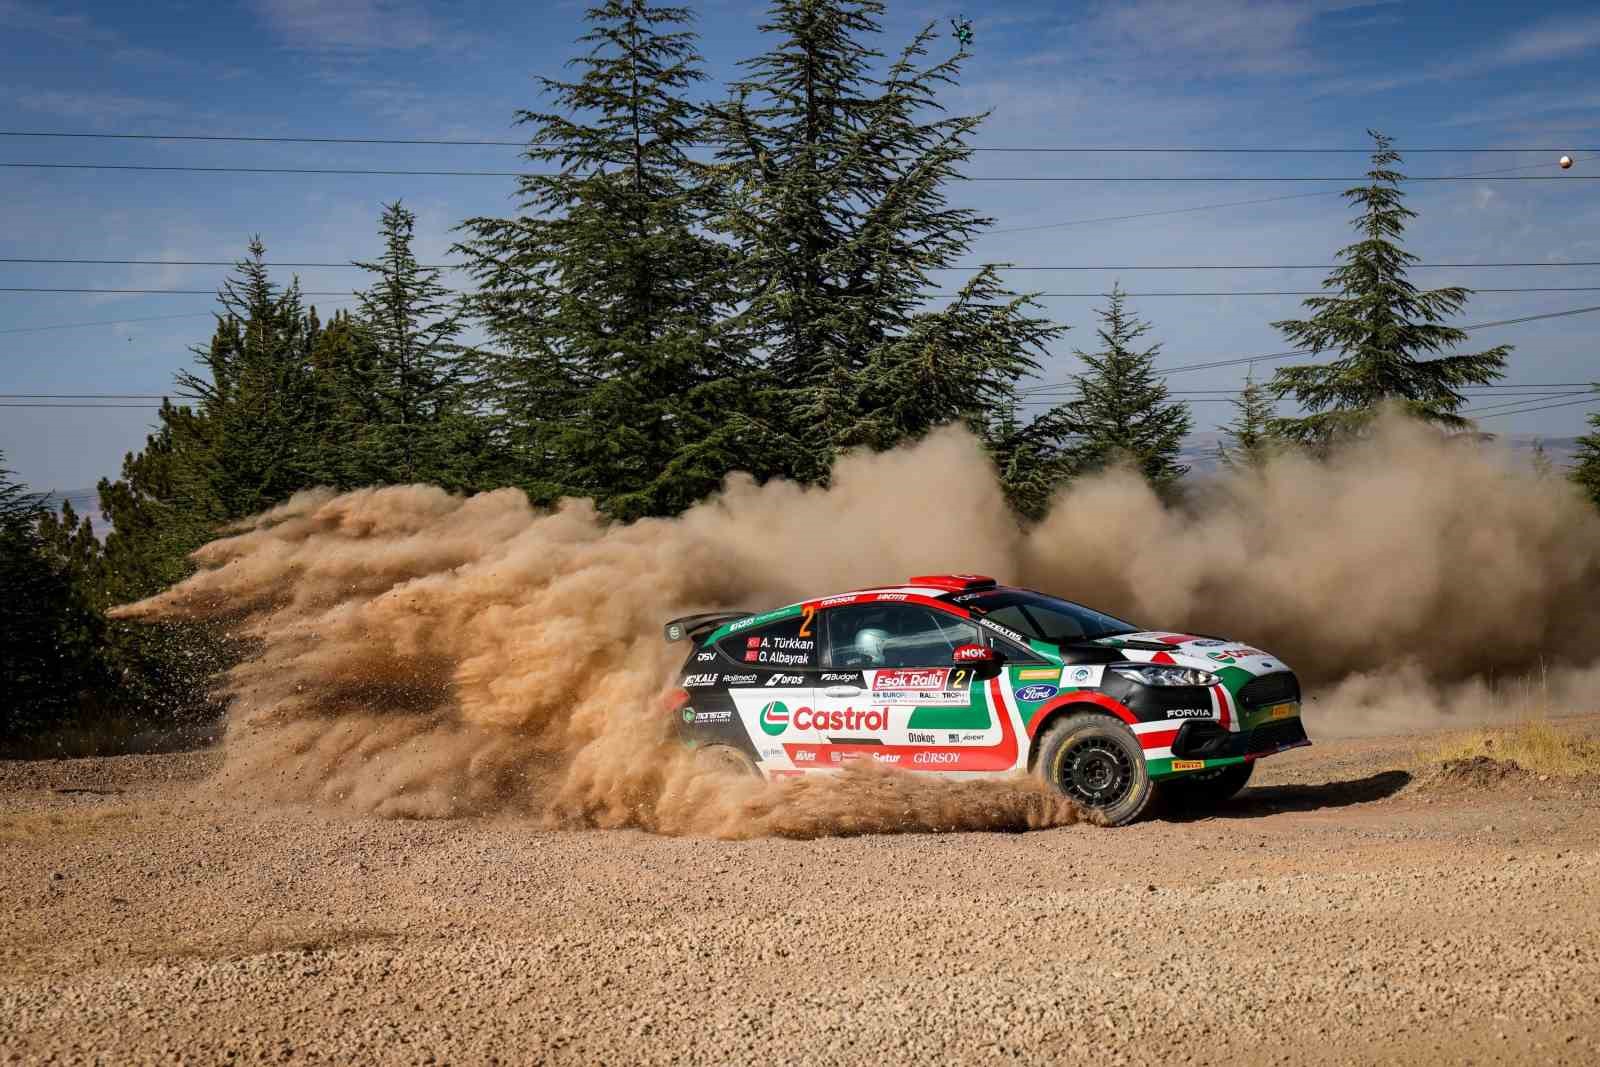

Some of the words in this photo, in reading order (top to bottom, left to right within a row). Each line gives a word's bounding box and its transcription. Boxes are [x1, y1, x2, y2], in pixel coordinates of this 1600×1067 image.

[799, 605, 815, 637] 2
[760, 638, 771, 648] A.
[774, 637, 814, 650] Türkkan
[697, 653, 717, 661] DSV
[769, 651, 809, 665] Albayrak
[961, 649, 986, 658] NGK
[781, 675, 805, 685] DFDS
[830, 673, 859, 683] Budget
[910, 673, 943, 688] Rally
[953, 670, 966, 689] 2
[793, 706, 889, 731] Castrol
[1166, 709, 1211, 718] FORVIA
[908, 732, 936, 744] Otokoç
[872, 752, 901, 763] Setur
[913, 751, 960, 763] GÜRSOY
